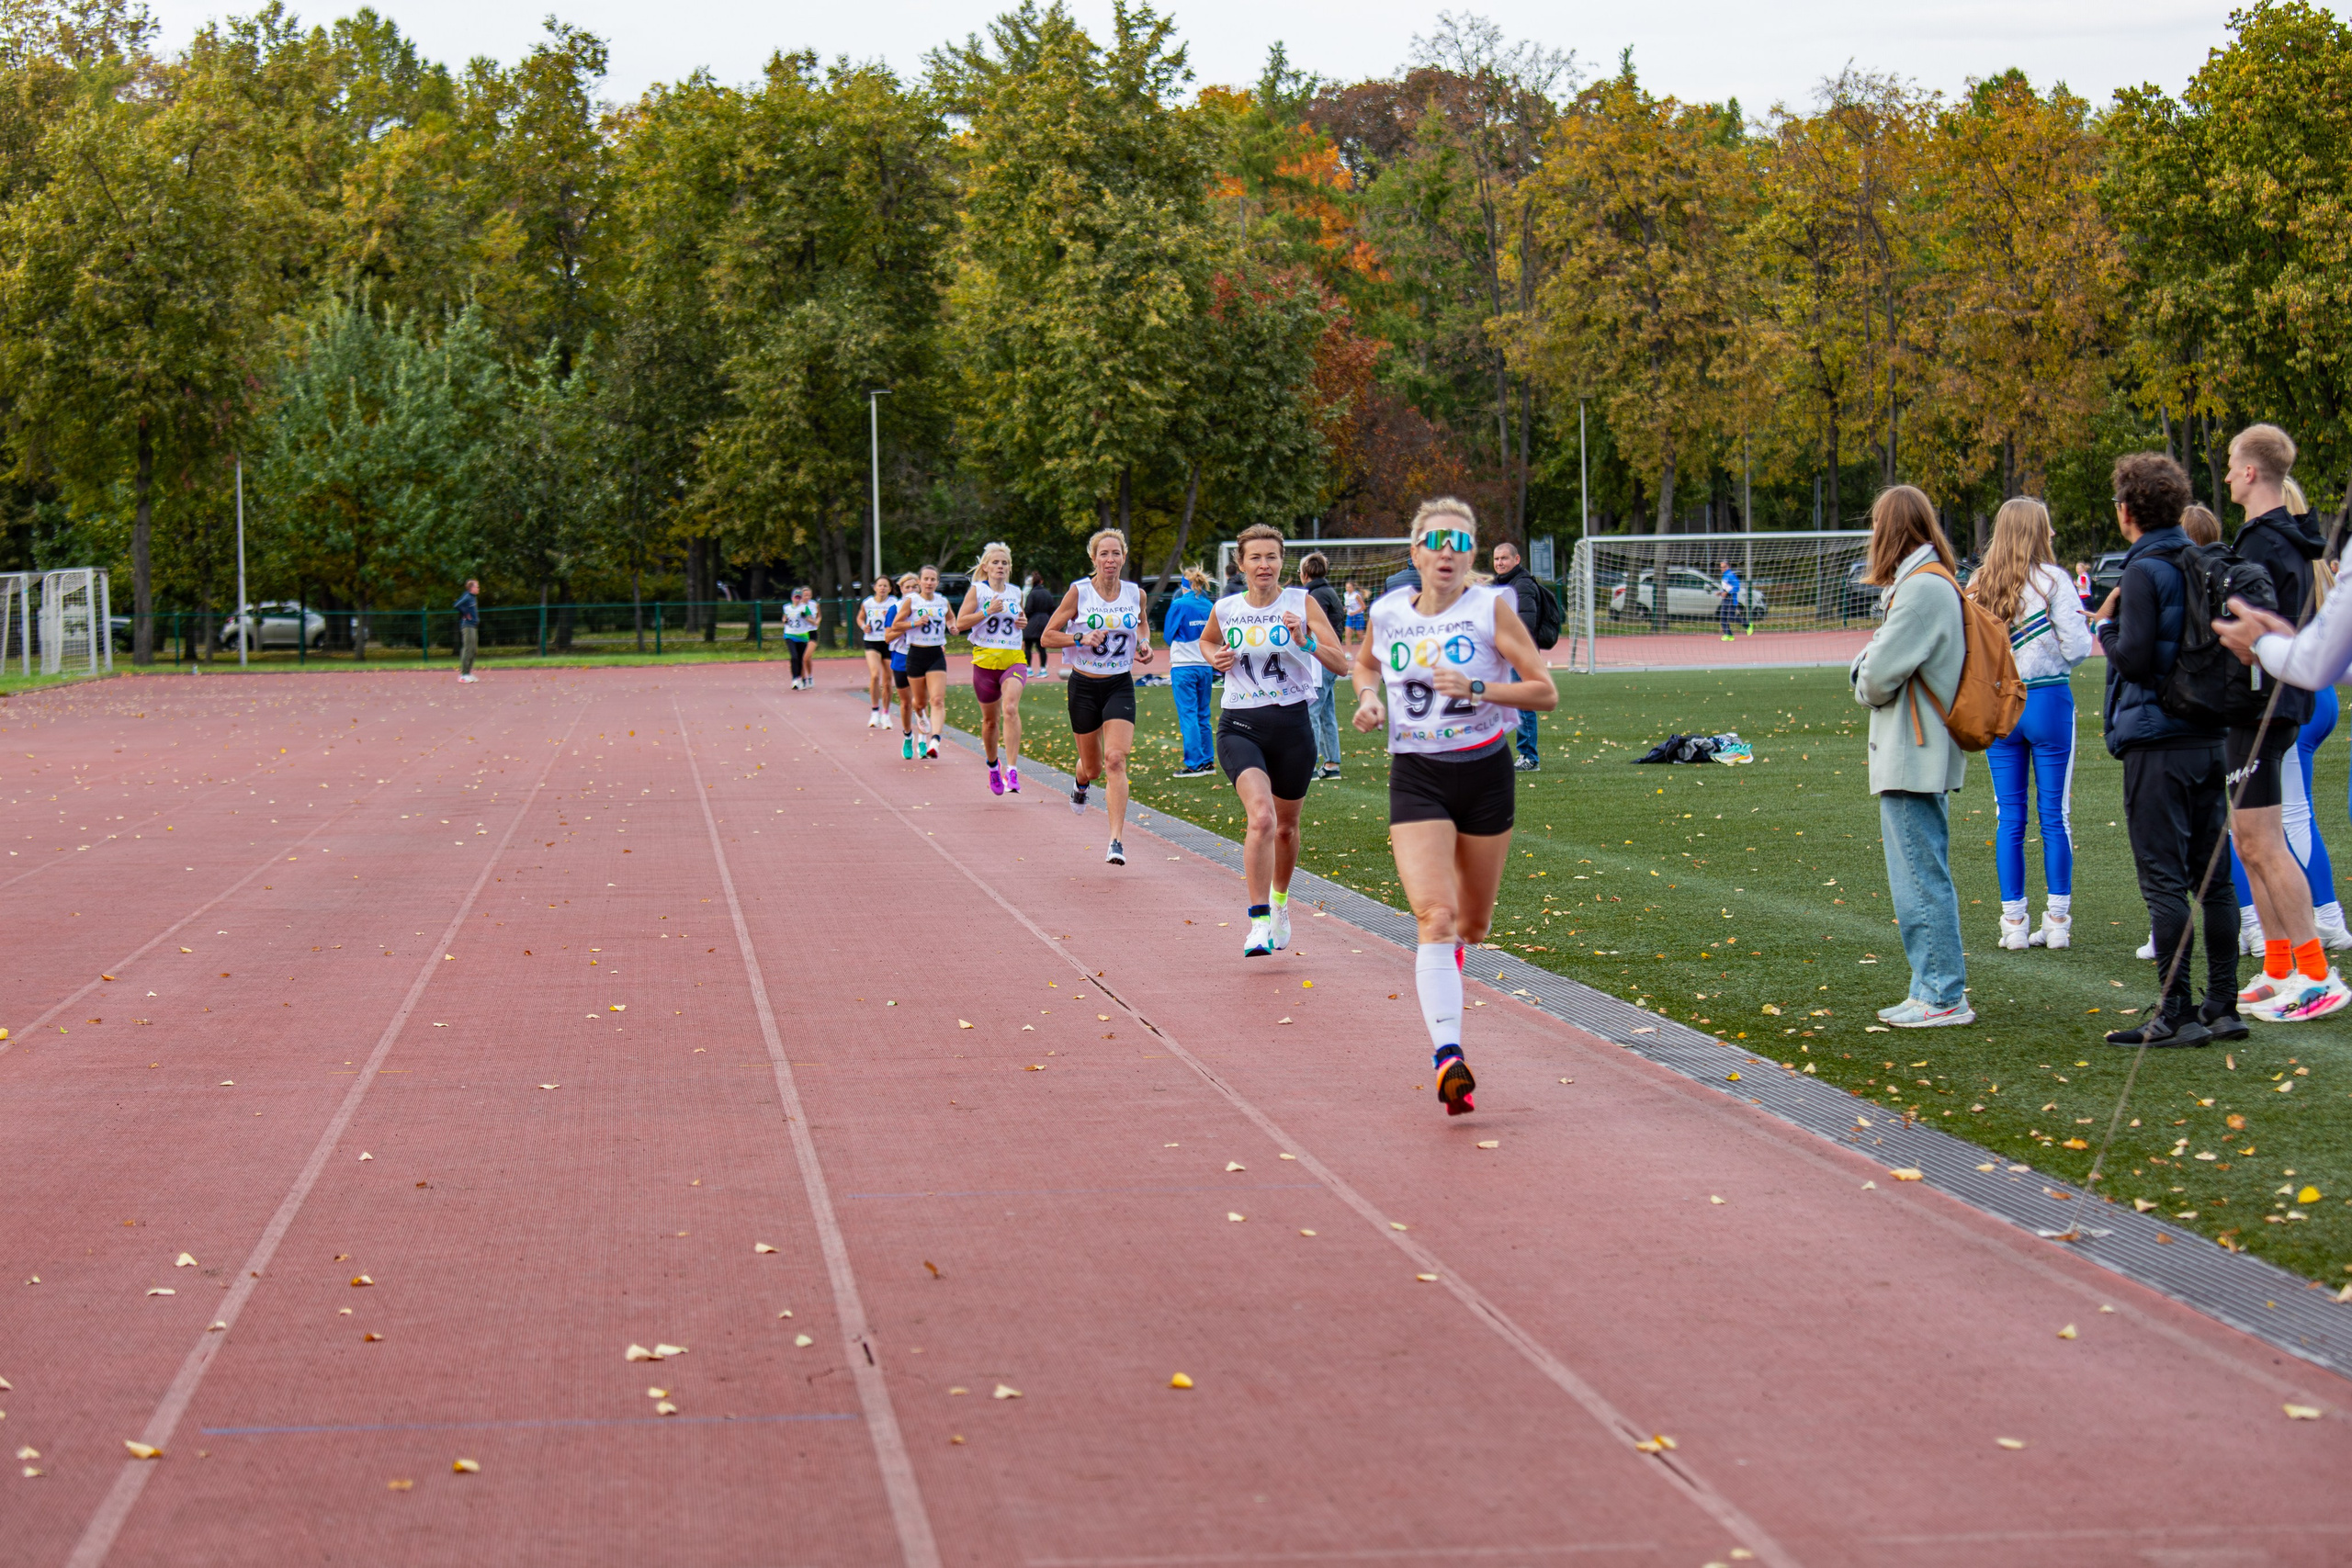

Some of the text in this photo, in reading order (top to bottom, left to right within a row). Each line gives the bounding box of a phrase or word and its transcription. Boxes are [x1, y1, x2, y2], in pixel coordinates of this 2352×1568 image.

[986, 615, 1014, 636] 93
[1226, 615, 1283, 626] VMARAFON
[1385, 621, 1475, 639] VMARAFONE
[1091, 632, 1130, 658] 82
[1240, 652, 1288, 685] 14
[1395, 713, 1499, 741] VMARAFONE.CLUB
